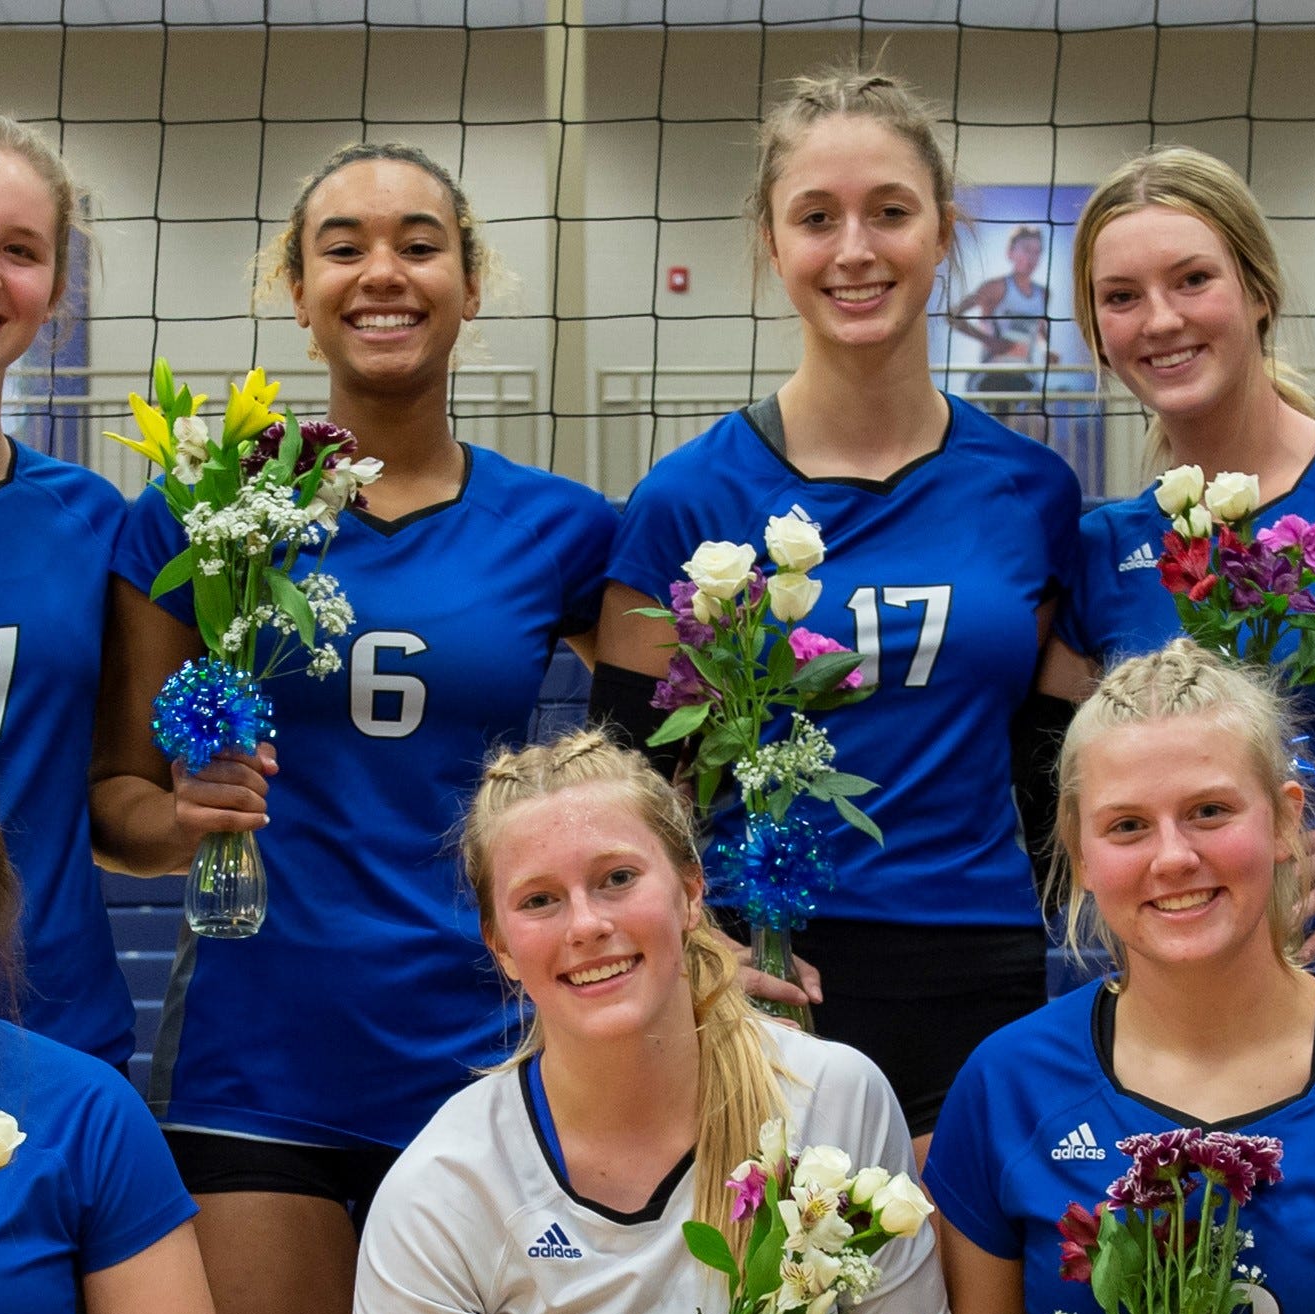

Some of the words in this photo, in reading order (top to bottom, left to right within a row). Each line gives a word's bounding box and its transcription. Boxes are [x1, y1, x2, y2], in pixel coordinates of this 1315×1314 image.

[845, 584, 952, 688] 17
[349, 629, 428, 739] 6
[1051, 1144, 1106, 1160] adidas
[528, 1244, 583, 1259] adidas
